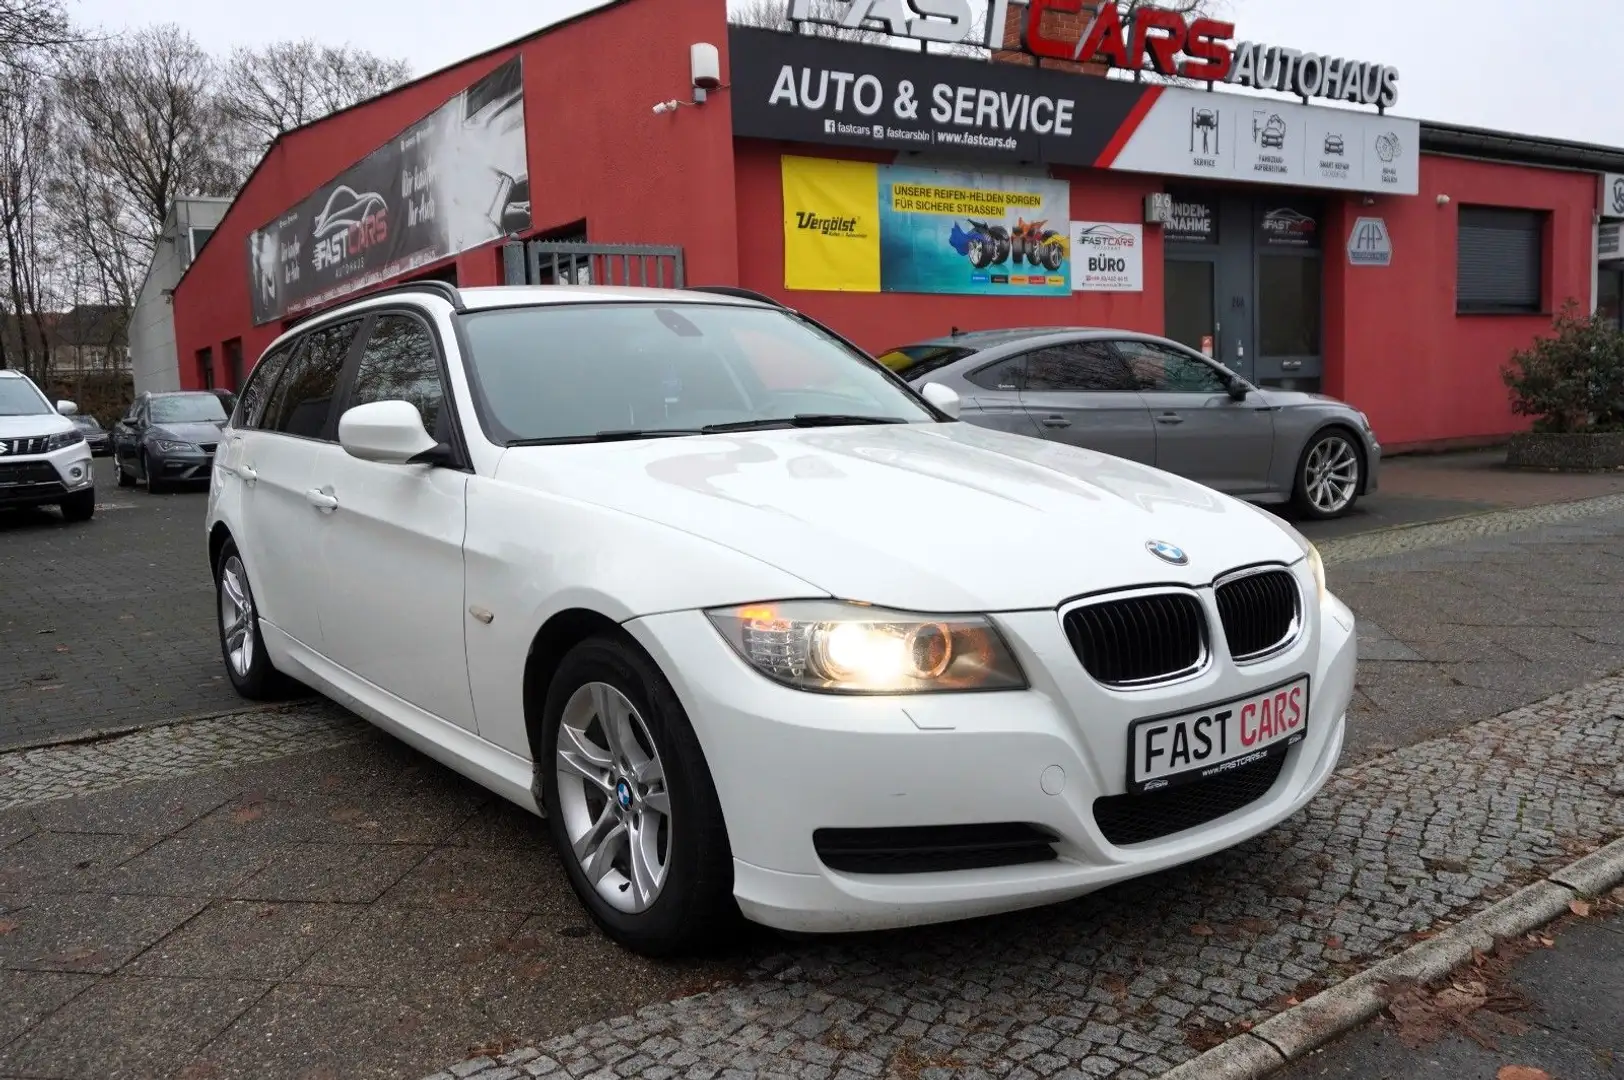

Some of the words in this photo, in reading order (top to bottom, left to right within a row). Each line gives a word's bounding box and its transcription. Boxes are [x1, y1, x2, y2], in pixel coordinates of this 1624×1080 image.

[1230, 41, 1399, 107] AUTOHAUS
[768, 65, 884, 115] AUTO
[893, 80, 919, 120] &
[930, 83, 1075, 136] SERVICE
[837, 122, 871, 136] fastcars
[937, 131, 1018, 149] www.fastcars.de
[1193, 158, 1216, 168] SERVICE
[894, 185, 932, 197] UNSERE
[934, 188, 1004, 203] REIFEN-HELDEN
[1005, 194, 1041, 206] SORGEN
[895, 198, 913, 209] FÜR
[916, 201, 955, 213] SICHERE
[957, 204, 1005, 216] STRASSEN!
[796, 211, 857, 235] Vergölst
[1088, 253, 1126, 273] BÜRO
[1145, 709, 1233, 773] FAST
[1240, 686, 1301, 746] CARS
